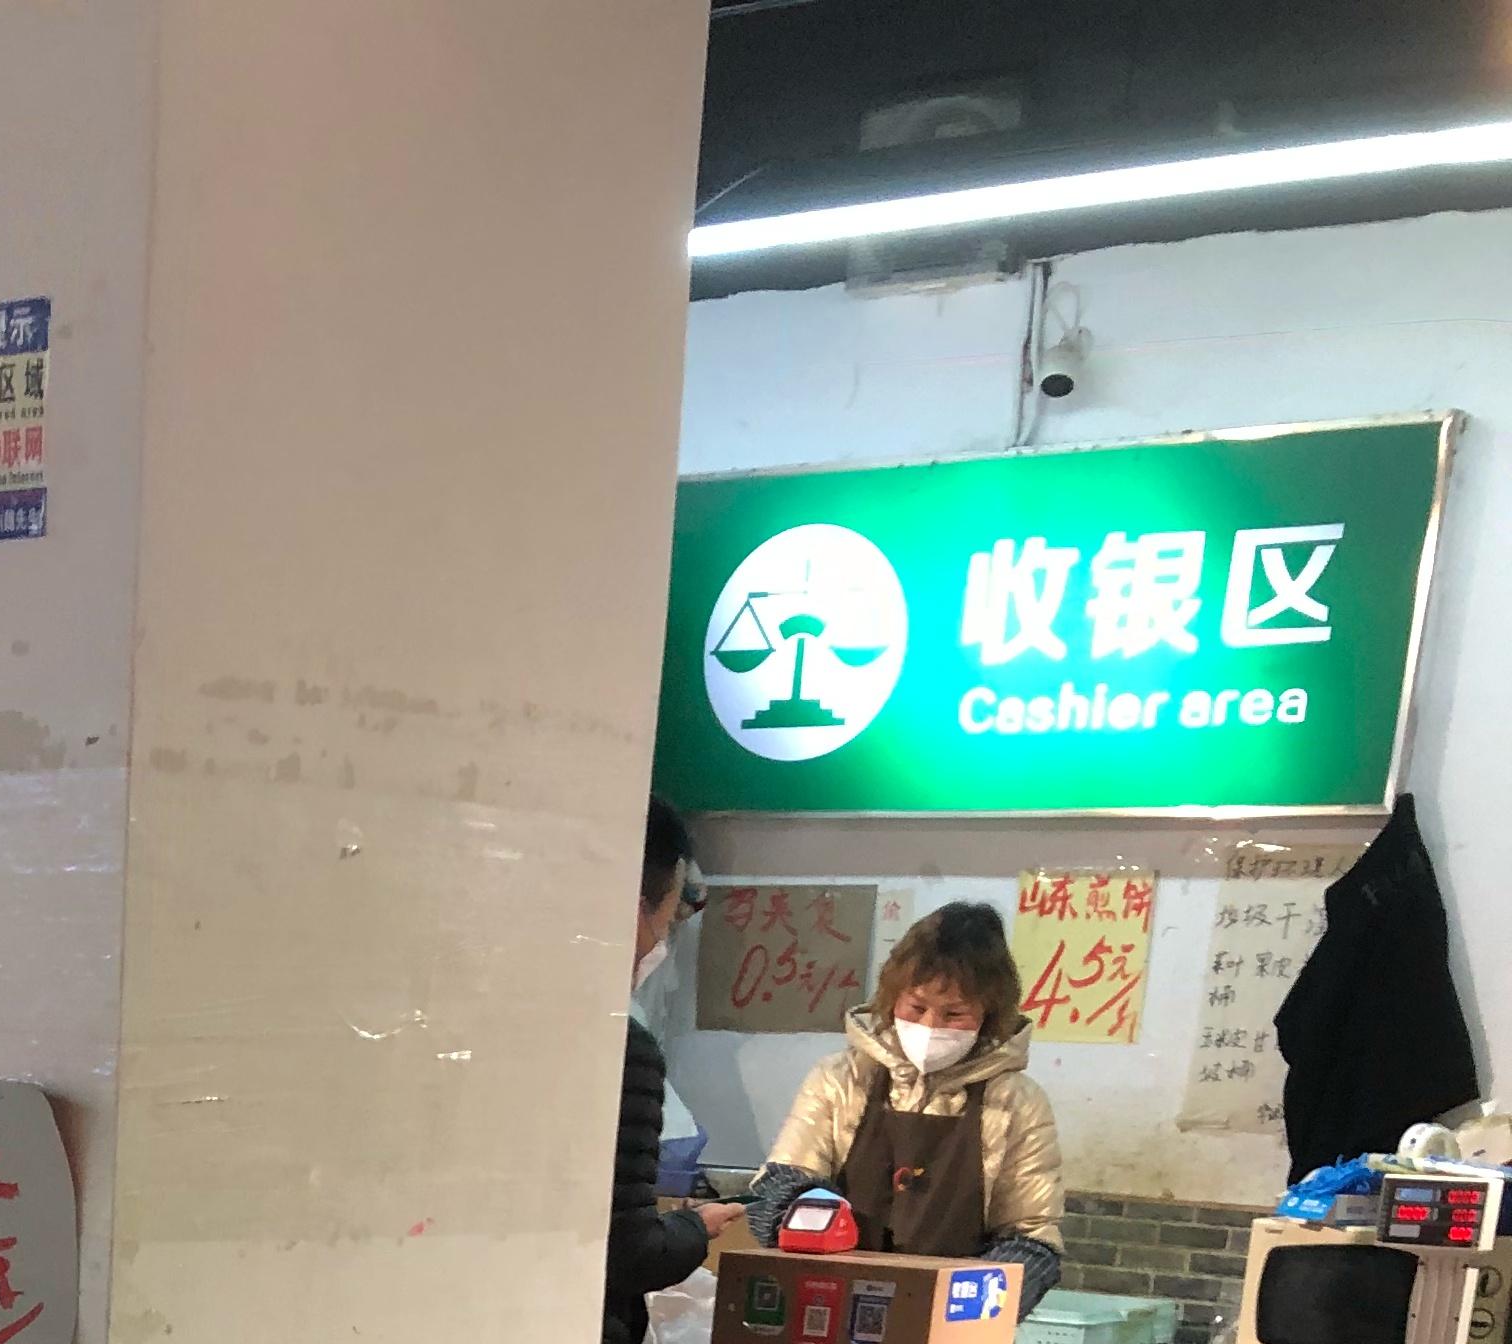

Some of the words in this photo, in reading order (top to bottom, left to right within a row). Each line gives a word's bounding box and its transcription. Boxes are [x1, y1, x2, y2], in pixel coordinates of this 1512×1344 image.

[959, 523, 1345, 664] 收银区
[958, 682, 1168, 735] Cashier
[1180, 687, 1307, 731] area
